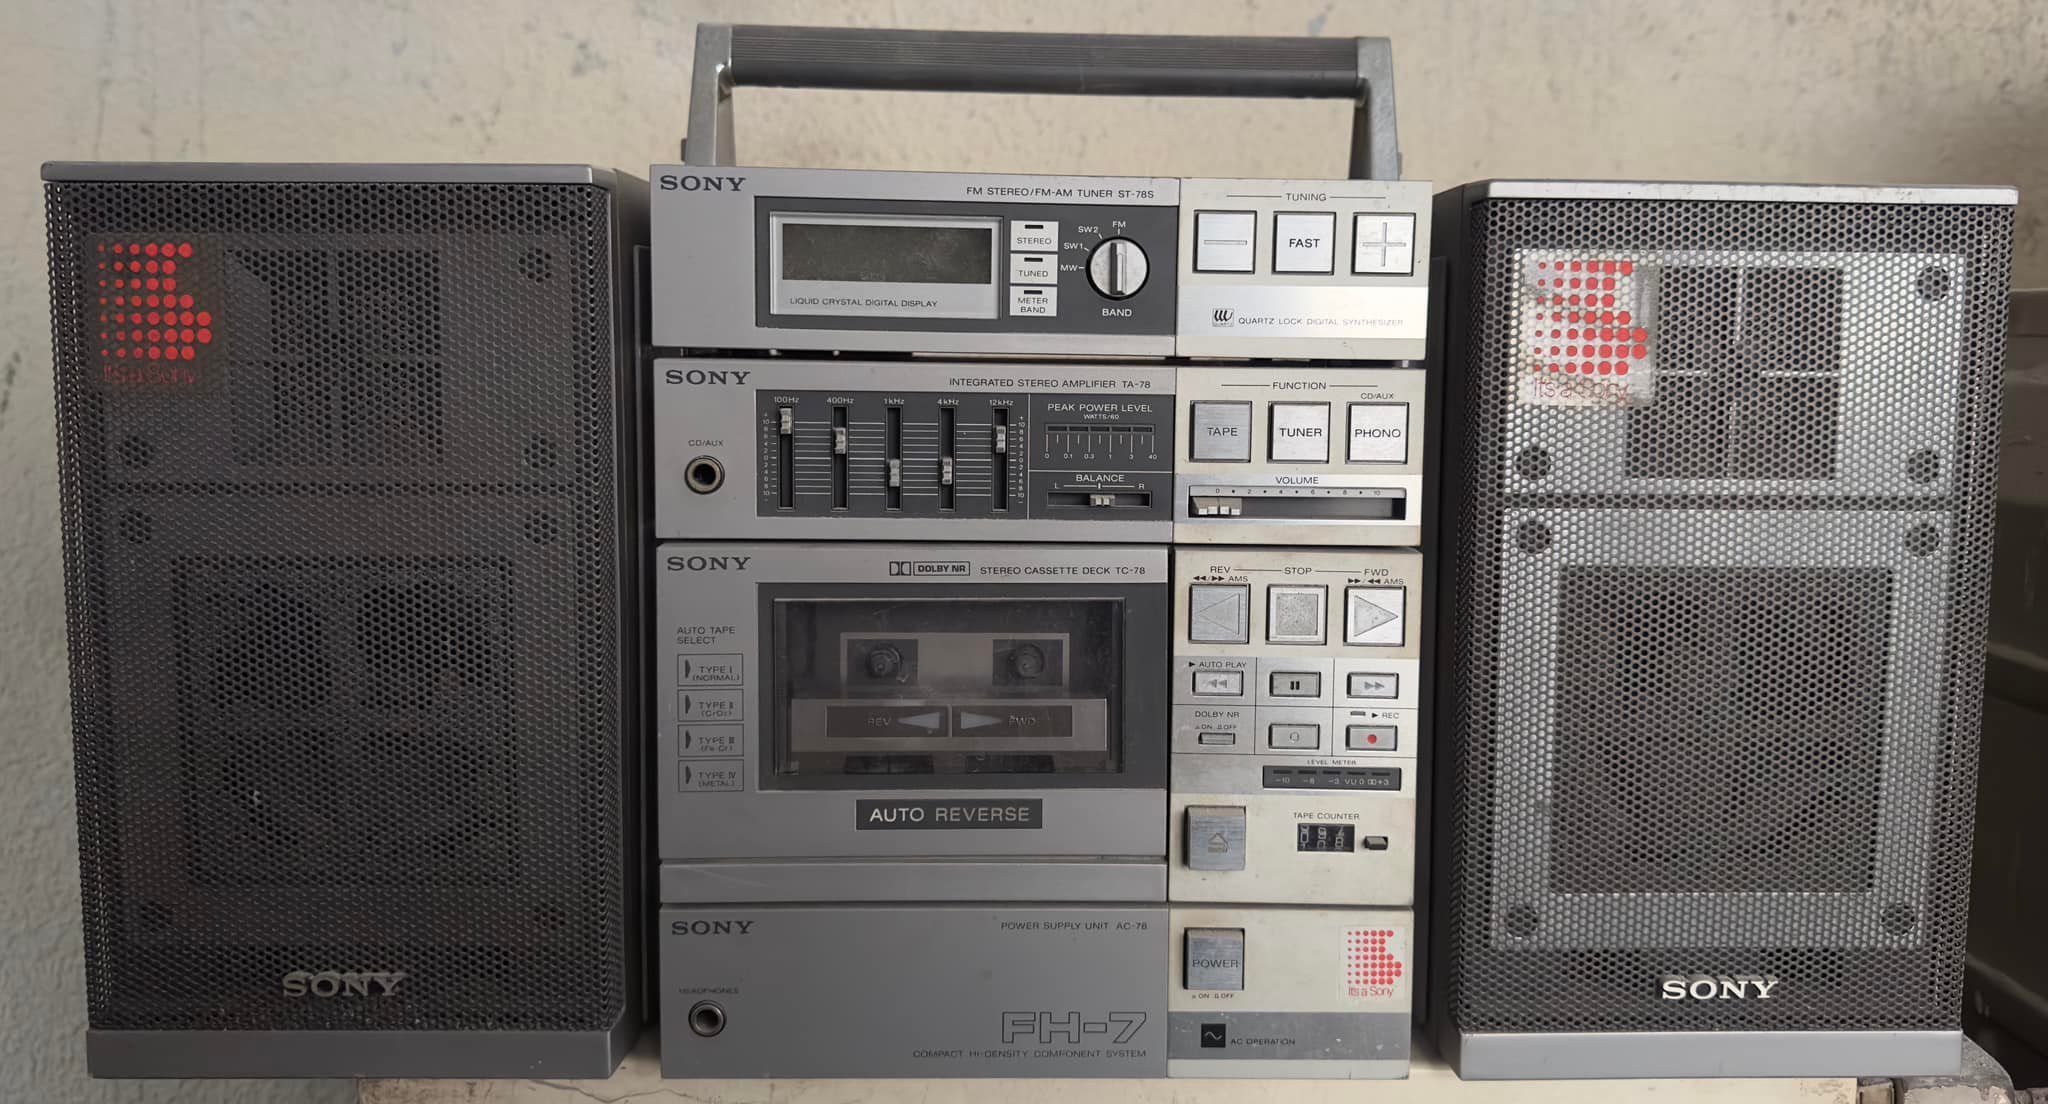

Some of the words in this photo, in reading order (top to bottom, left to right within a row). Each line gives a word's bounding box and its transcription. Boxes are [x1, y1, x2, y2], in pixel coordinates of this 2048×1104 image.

[660, 175, 746, 192] SONY
[966, 187, 983, 196] FM
[987, 187, 1073, 198] STEREO/FM-AM
[1078, 189, 1113, 198] TUNER
[1118, 190, 1154, 199] ST-78S
[1285, 192, 1328, 202] TUNING
[1112, 221, 1126, 229] FM
[1016, 237, 1052, 246] STEREO
[1289, 238, 1321, 248] FAST
[1060, 264, 1078, 273] MW
[1018, 269, 1049, 278] TUNED
[790, 297, 820, 306] LIQUID
[822, 298, 863, 306] CRYSTAL
[865, 299, 899, 307] DIGITAL
[901, 300, 938, 308] DISPLAY
[1018, 297, 1049, 305] METER
[1021, 306, 1046, 314] BAND
[1102, 308, 1132, 318] BAND
[1238, 317, 1275, 326] QUARTZ
[1278, 318, 1303, 326] LOCK
[1306, 318, 1338, 326] DIGITAL
[1342, 319, 1404, 327] SYNTHESIZER
[665, 369, 751, 385] SONY
[949, 378, 1014, 387] INTEGRATED
[1017, 379, 1058, 388] STEREO
[1062, 380, 1116, 388] AMPLIFIER
[1122, 380, 1151, 389] TA-78
[1272, 381, 1327, 391] FUNCTION
[774, 396, 799, 404] 100Hz
[1360, 392, 1394, 400] CD/AUX
[826, 397, 854, 405] 400Hz
[1047, 403, 1075, 412] PEAK
[1079, 404, 1118, 412] POWER
[1121, 404, 1153, 413] LEVEL
[1207, 428, 1238, 437] TAPE
[1280, 428, 1322, 437] TUNER
[1355, 429, 1401, 438] PHONO
[688, 439, 724, 447] CD/AUX
[1075, 474, 1125, 482] BALANCE
[1275, 476, 1319, 485] VOLUME
[666, 556, 751, 571] SONY
[918, 565, 949, 573] DOLBY
[951, 565, 966, 573] NR
[980, 566, 1021, 575] STEREO
[1024, 567, 1078, 575] CASSETTE
[1082, 567, 1110, 575] DECK
[1116, 567, 1145, 575] TC-78
[1210, 565, 1231, 574] REV
[1284, 567, 1312, 575] STOP
[1364, 568, 1389, 577] FWD
[677, 626, 706, 635] AUTO
[710, 626, 736, 634] TAPE
[677, 636, 716, 645] SELECT
[699, 665, 726, 674] TYPE
[692, 674, 740, 682] (NORMAL)
[699, 701, 726, 709] TYPE
[1195, 710, 1224, 718] DOLBY
[867, 717, 892, 727] REV
[699, 736, 725, 744] TYPE
[699, 772, 725, 780] TYPE
[870, 807, 925, 823] AUTO
[935, 807, 1030, 823] REVERSE
[1293, 812, 1313, 820] TAPE
[1317, 812, 1360, 821] COUNTER
[672, 920, 754, 935] SONY
[1001, 921, 1040, 931] POWER
[1043, 922, 1081, 931] SUPPLY
[1085, 922, 1109, 931] UNIT
[1116, 922, 1148, 931] AC-78
[1192, 959, 1239, 969] POWER
[283, 970, 407, 997] SONY
[678, 987, 740, 995] HEADPHONES
[1369, 986, 1394, 998] Sony
[1662, 980, 1779, 999] SONY
[1001, 1011, 1148, 1044] FH-7
[1230, 1038, 1244, 1046] AC
[1246, 1038, 1296, 1046] OPERATION
[913, 1049, 963, 1058] COMPACT
[969, 1049, 1028, 1058] HI-DENSITY
[1034, 1049, 1101, 1058] COMPONENT
[1106, 1049, 1147, 1058] SYSTEM
